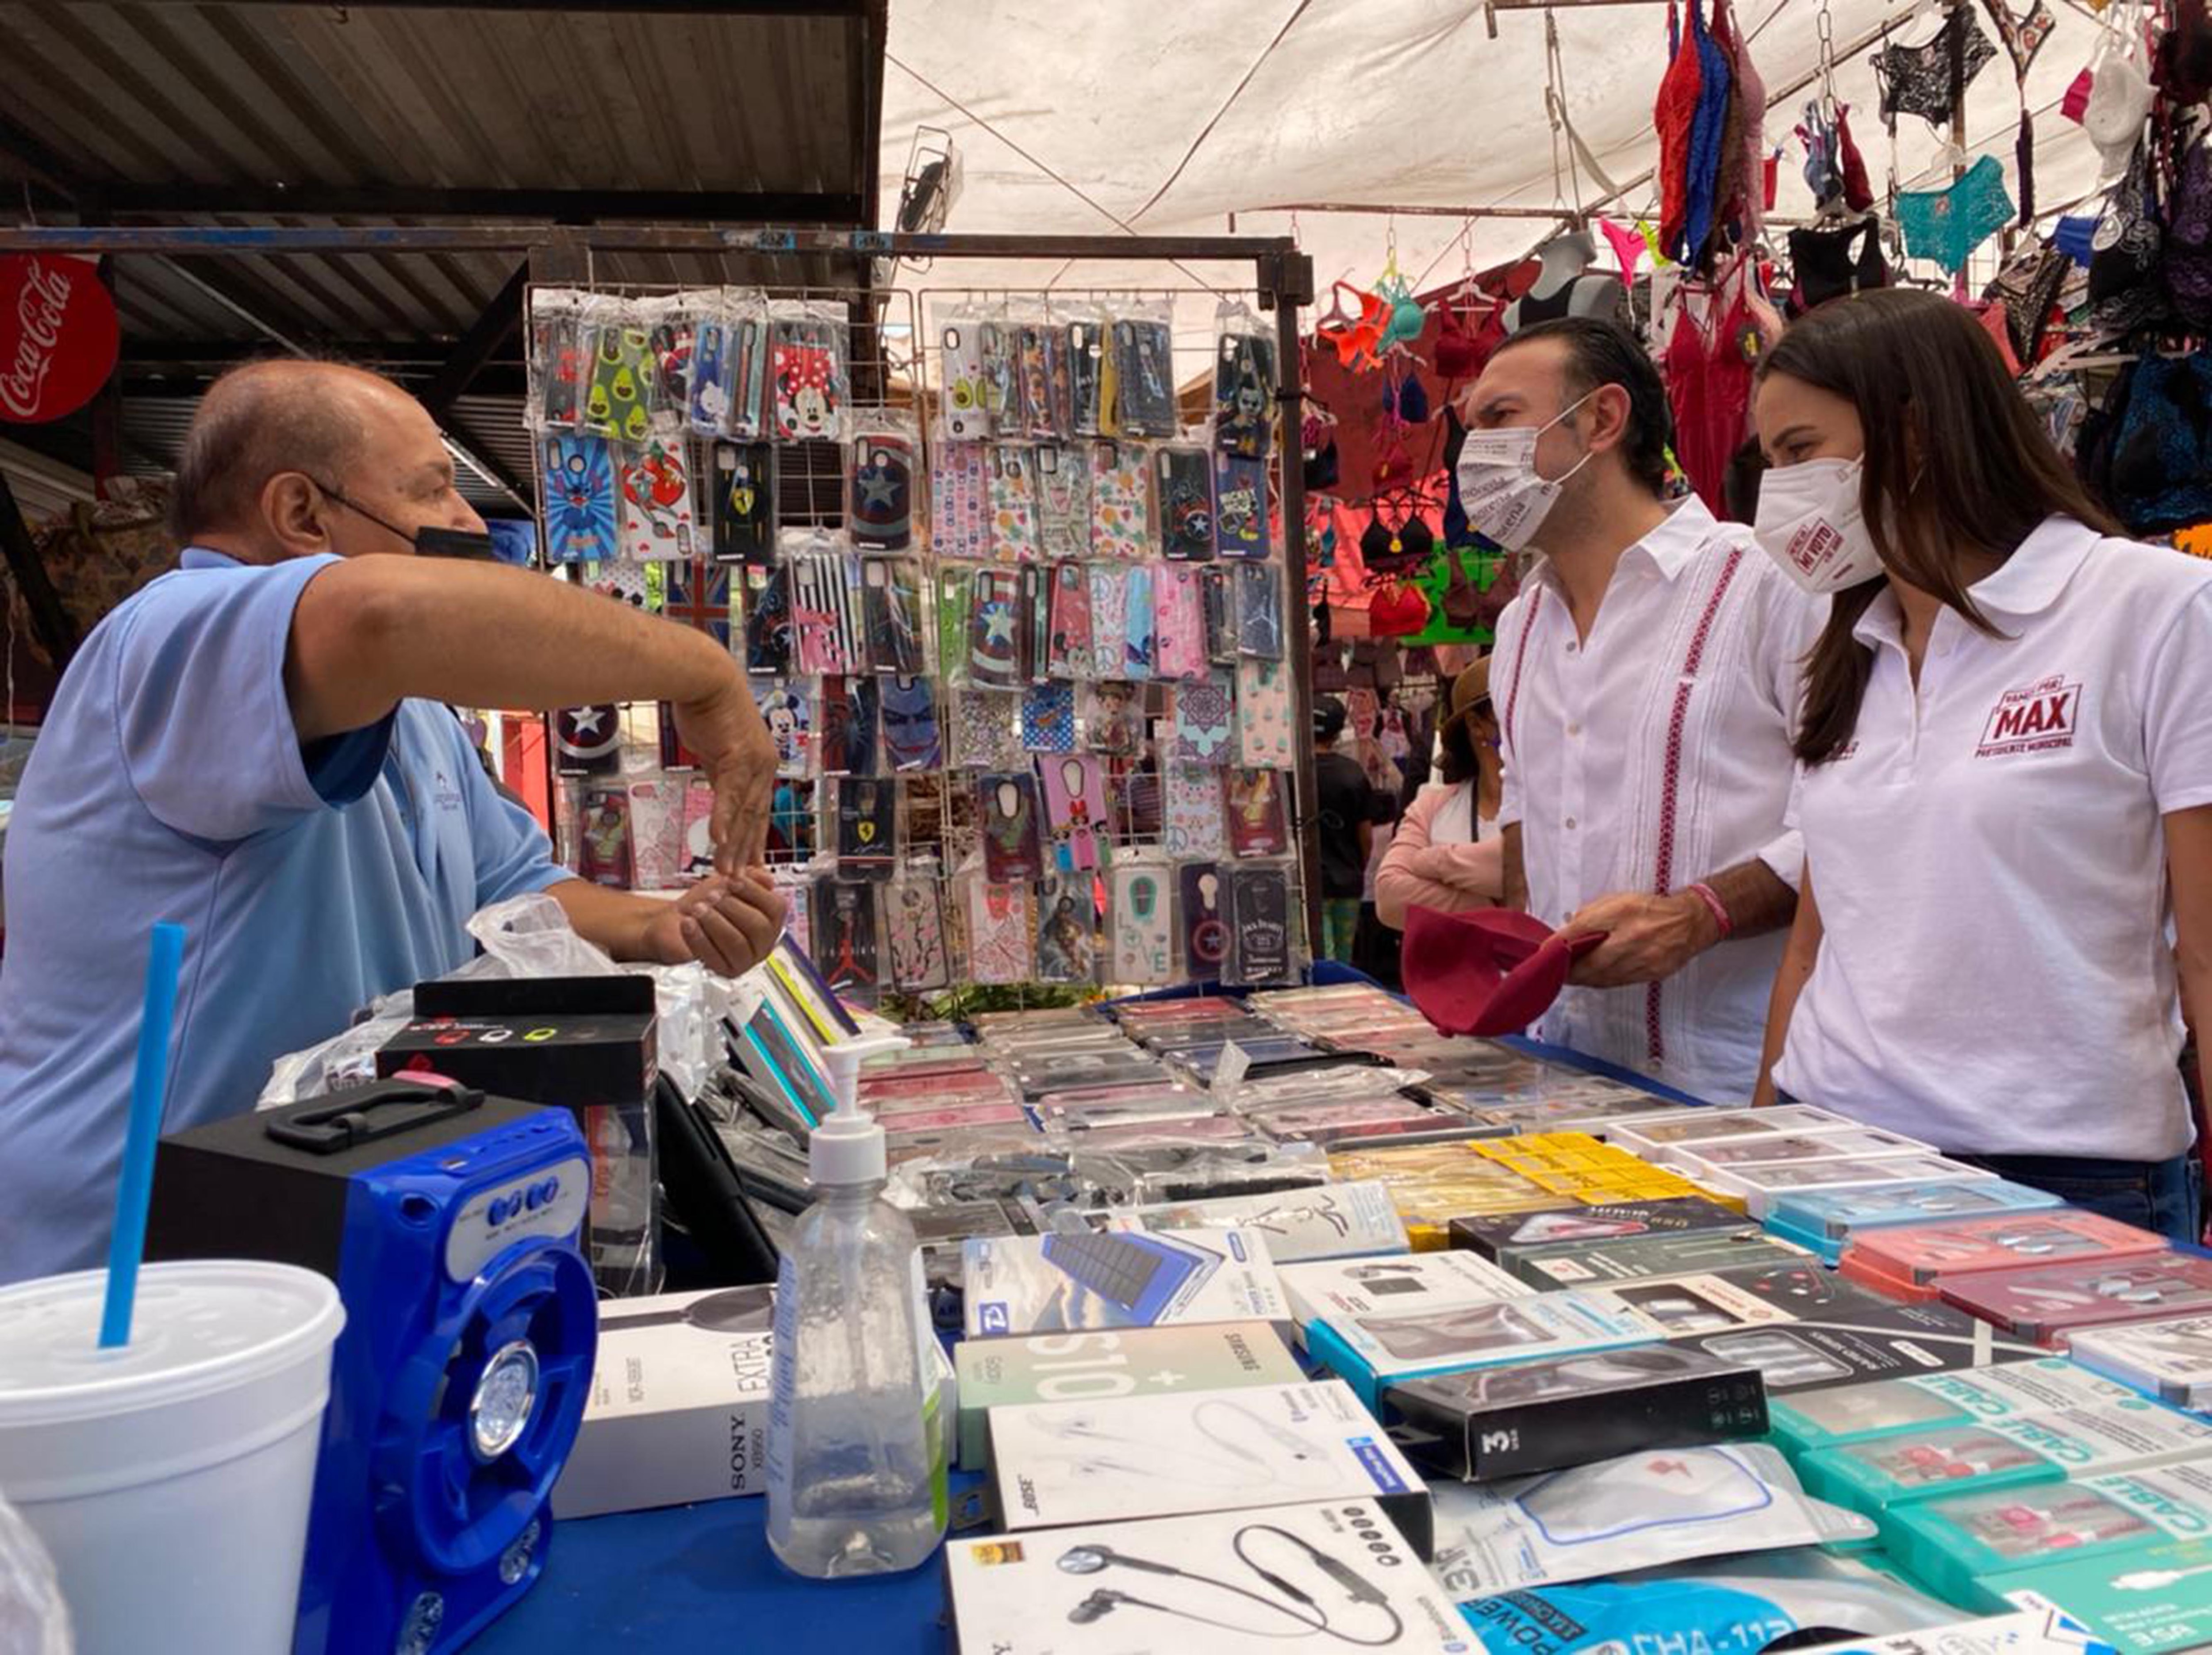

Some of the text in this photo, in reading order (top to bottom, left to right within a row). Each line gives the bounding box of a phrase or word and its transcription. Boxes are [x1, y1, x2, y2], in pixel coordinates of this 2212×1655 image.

[1994, 693, 2070, 739] MAX
[730, 1337, 769, 1393] EXTRA
[730, 1416, 746, 1490] SONY
[1992, 1419, 2093, 1463] CABLE
[2097, 1476, 2208, 1532] CABLE
